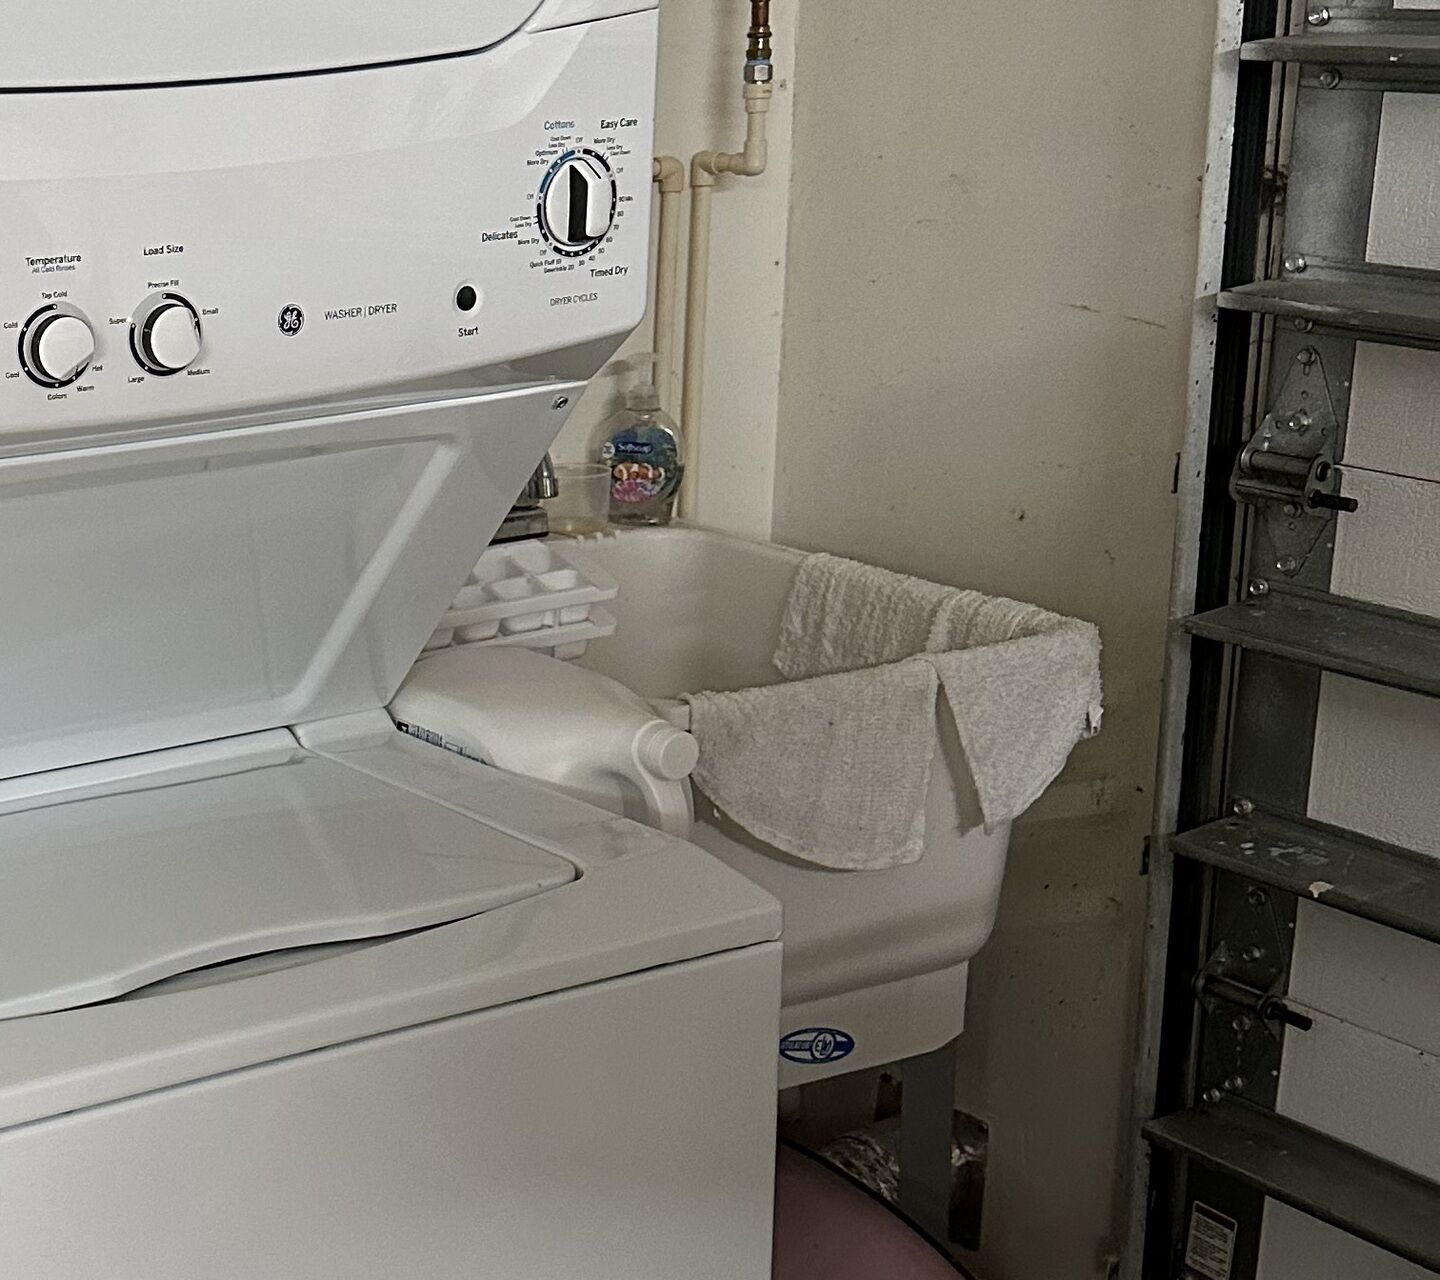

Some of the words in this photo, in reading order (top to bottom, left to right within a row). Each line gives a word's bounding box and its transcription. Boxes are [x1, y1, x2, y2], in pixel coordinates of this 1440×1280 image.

[544, 120, 575, 130] Cottons
[601, 120, 618, 130] Easy
[620, 118, 638, 128] Care
[606, 136, 615, 144] Dry
[540, 158, 549, 166] Dry
[482, 230, 518, 242] Delicates
[143, 246, 164, 256] Load
[166, 244, 184, 254] Size
[25, 254, 82, 268] Temperature
[590, 267, 613, 278] Timed
[615, 265, 629, 276] Dry
[550, 294, 572, 306] DRYER
[572, 292, 598, 304] CYCLES
[324, 307, 362, 320] WASHER
[368, 303, 397, 316] DRYER
[458, 326, 479, 338] Start
[5, 371, 20, 379] Cool
